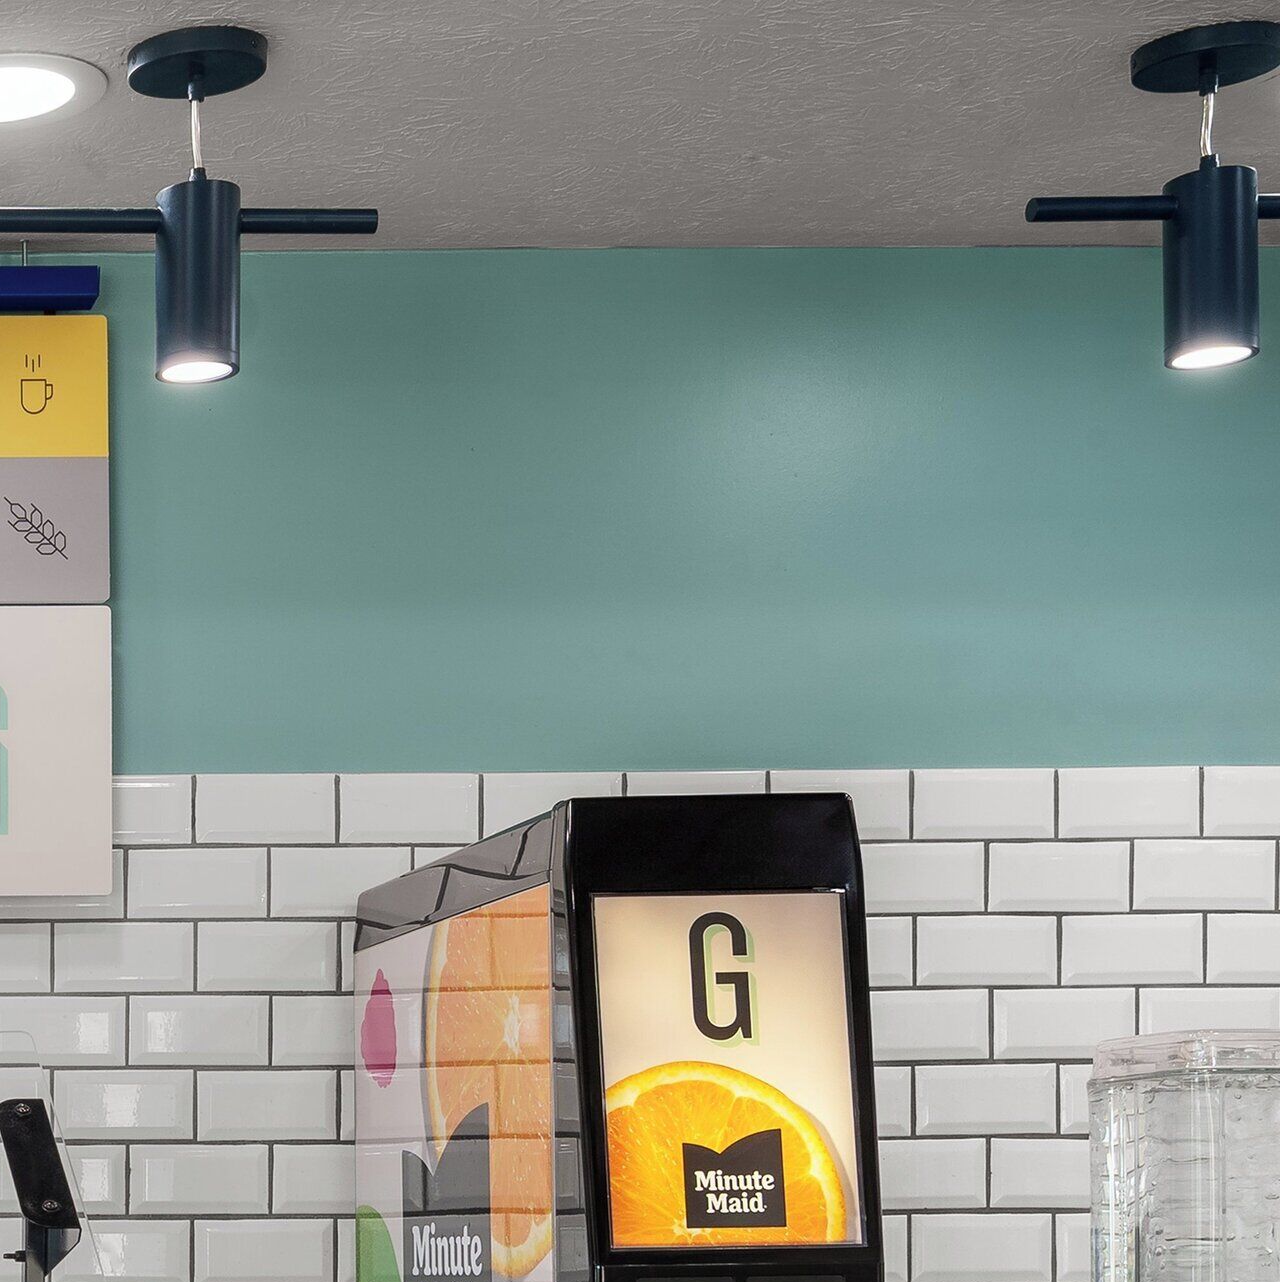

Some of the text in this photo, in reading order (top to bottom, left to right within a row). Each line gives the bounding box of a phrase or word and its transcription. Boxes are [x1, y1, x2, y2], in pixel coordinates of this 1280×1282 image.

[689, 911, 756, 1042] G
[694, 1170, 775, 1191] Minute
[706, 1192, 765, 1213] Maid
[412, 1222, 483, 1276] Minute
